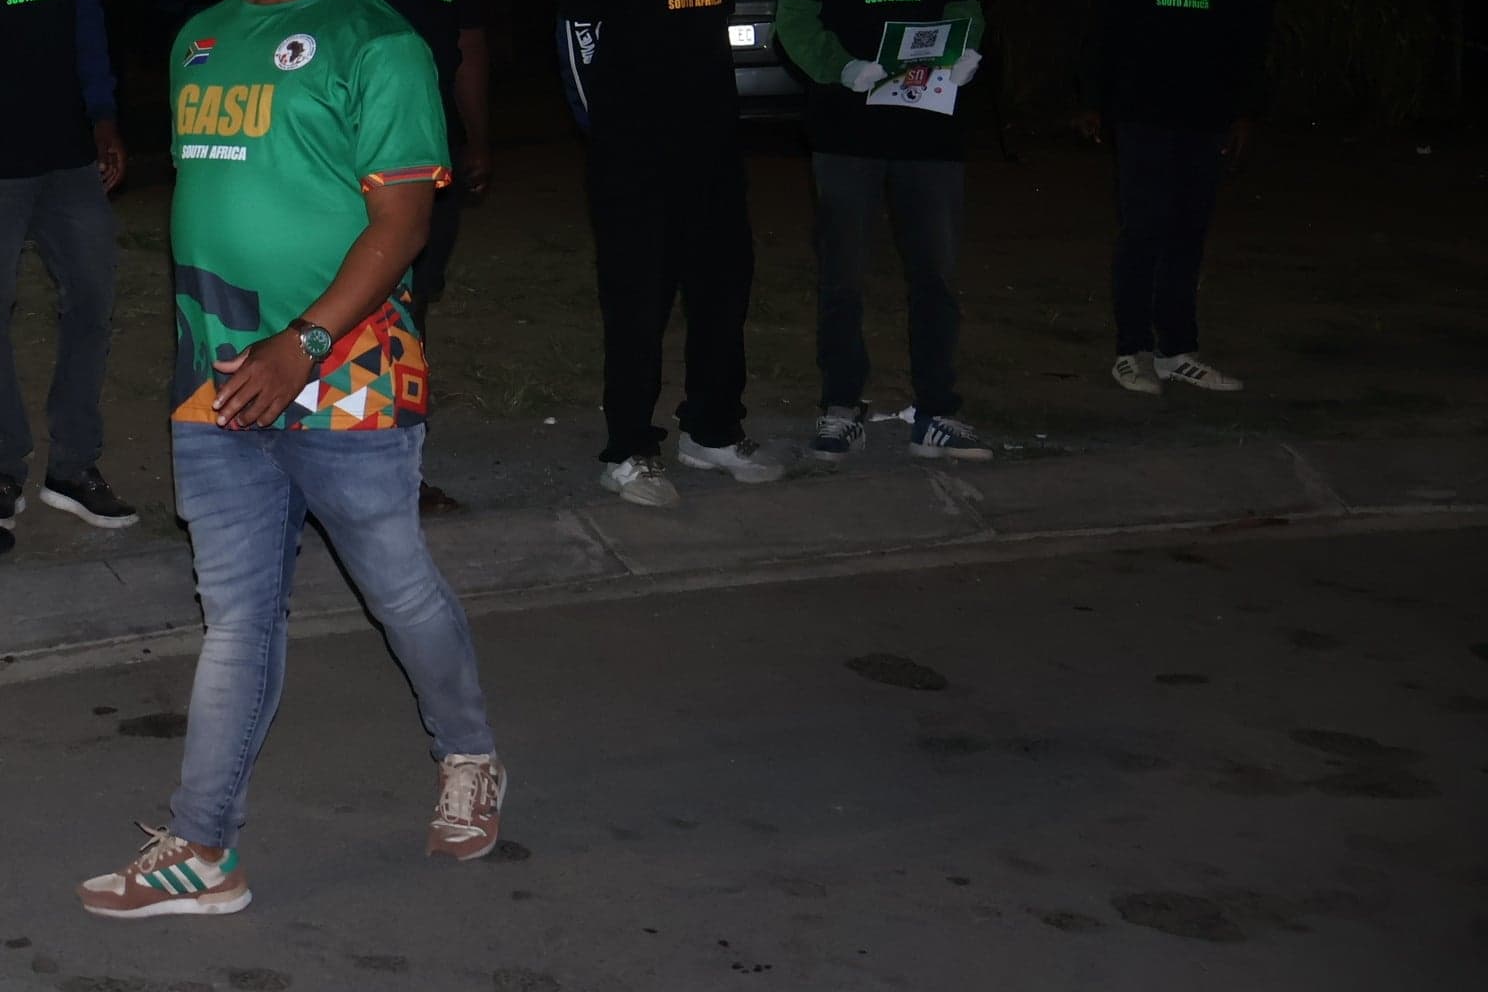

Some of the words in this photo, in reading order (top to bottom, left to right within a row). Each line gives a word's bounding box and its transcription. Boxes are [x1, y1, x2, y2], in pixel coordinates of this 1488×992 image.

[177, 83, 275, 138] GASU
[181, 144, 208, 160] SOUTH
[209, 144, 247, 161] AFRICA
